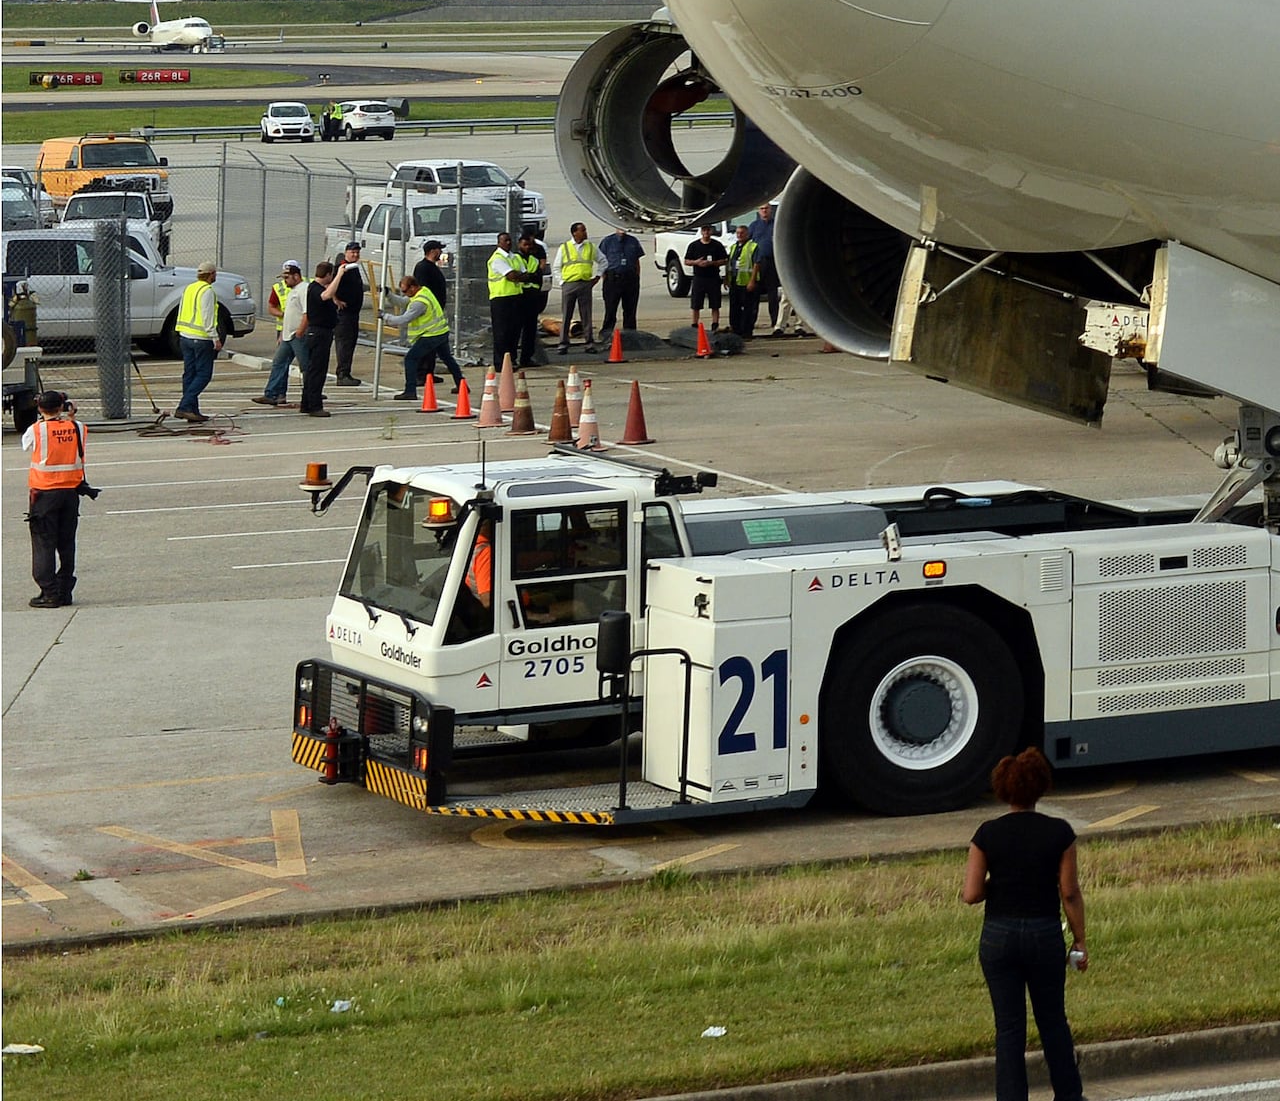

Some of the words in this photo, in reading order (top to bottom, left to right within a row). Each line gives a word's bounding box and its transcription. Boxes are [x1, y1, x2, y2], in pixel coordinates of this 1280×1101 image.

[85, 75, 97, 84] 8L
[141, 73, 161, 81] 26R
[172, 72, 184, 81] 8L
[1123, 315, 1146, 328] DEL
[57, 436, 73, 444] TUG
[831, 570, 900, 588] DELTA
[337, 626, 362, 646] DELTA
[507, 635, 597, 656] Goldho
[380, 641, 421, 669] Goldhofer
[524, 656, 585, 678] 2705
[718, 649, 788, 756] 21
[718, 773, 784, 794] AST
